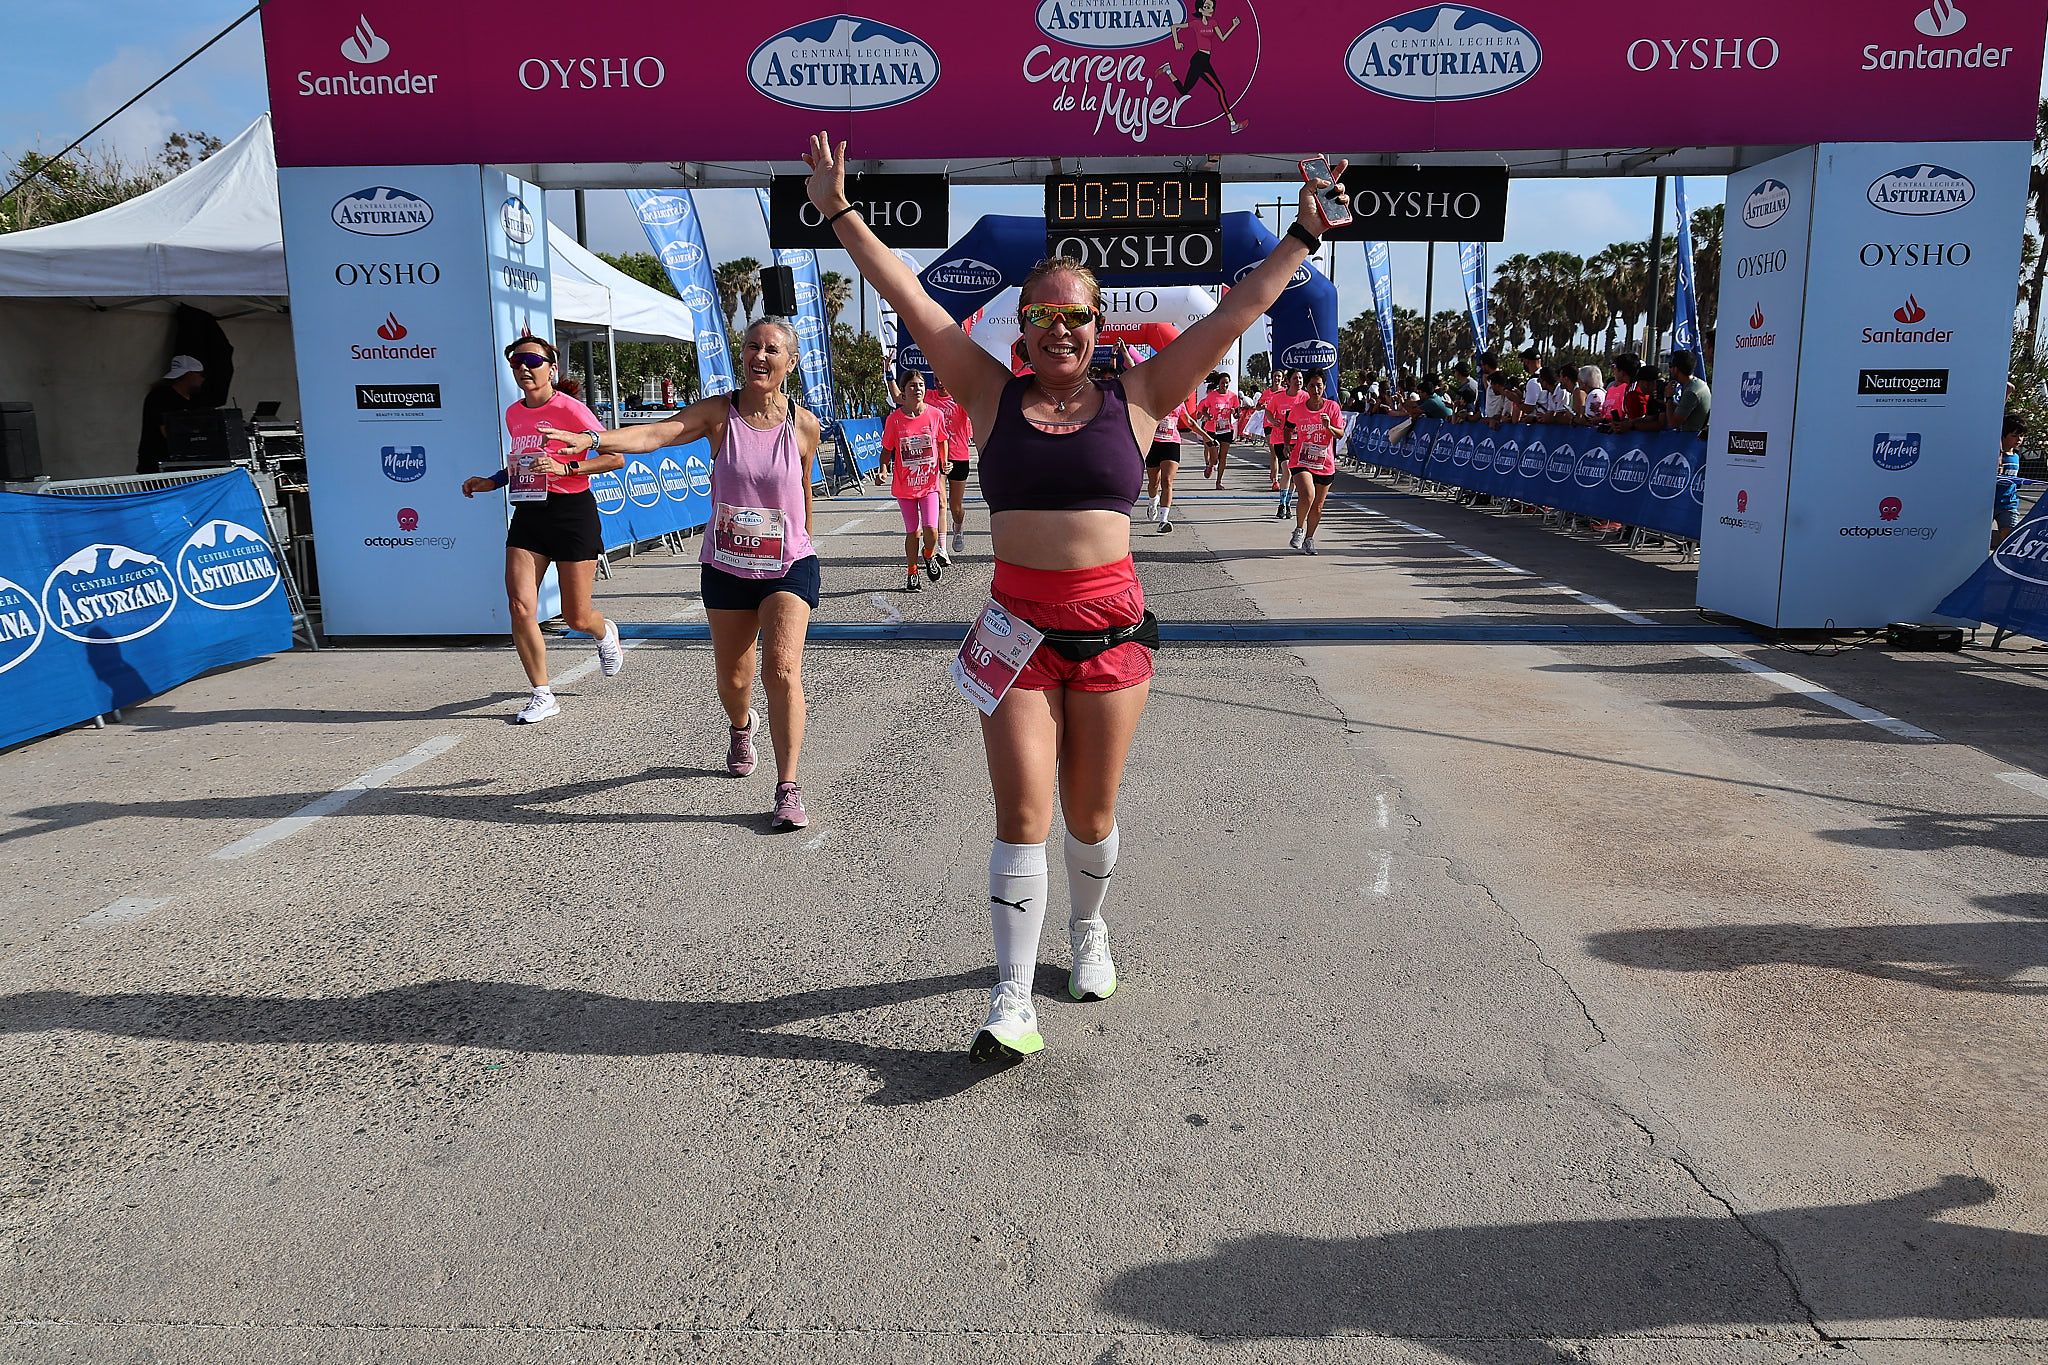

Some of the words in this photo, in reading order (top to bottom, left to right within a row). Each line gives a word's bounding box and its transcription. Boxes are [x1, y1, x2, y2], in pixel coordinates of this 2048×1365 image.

[1047, 2, 1174, 30] ASTURIANA
[791, 48, 850, 58] CENTRAL
[857, 48, 919, 57] LECHERA
[1391, 38, 1453, 48] CENTRAL
[1459, 37, 1521, 46] LECHERA
[1022, 44, 1146, 83] Carrera
[1359, 41, 1526, 77] ASTURIANA
[1627, 37, 1779, 71] OYSHO
[1862, 42, 2013, 70] Santander
[518, 56, 665, 90] OYSHO
[763, 52, 926, 86] ASTURIANA
[297, 69, 438, 96] Santander
[1052, 85, 1075, 112] de
[1080, 83, 1097, 112] la
[1093, 78, 1192, 143] Mujer
[1058, 181, 1208, 219] 00:36:04
[1874, 183, 1966, 203] ASTURIANA
[339, 205, 427, 224] ASTURIANA
[799, 200, 922, 227] OHO
[1353, 190, 1480, 219] OYSHO
[1745, 198, 1786, 220] ASTURIANA
[1055, 233, 1213, 268] OYSHO
[1859, 243, 1971, 266] OYSHO
[335, 262, 440, 286] OYSHO
[1737, 249, 1787, 279] OYSHO
[503, 265, 539, 292] OYSHO
[931, 270, 996, 286] ASTURIANA
[1735, 332, 1777, 349] Santander
[1862, 328, 1953, 343] Santander
[351, 344, 437, 360] Santander
[1865, 374, 1941, 391] Neutrogena
[361, 389, 435, 406] Neutrogena
[1730, 435, 1764, 452] Neutrogena
[1875, 441, 1918, 461] Marlene
[384, 453, 424, 473] Marlene
[519, 475, 535, 483] 016
[1650, 468, 1686, 489] ASTURIANA
[1720, 516, 1743, 528] octopus
[1839, 525, 1892, 539] octopus
[1893, 526, 1938, 540] energy
[364, 536, 414, 548] octopus
[414, 537, 456, 550] energy
[733, 535, 761, 547] 016
[197, 551, 231, 564] CENTRAL
[232, 544, 264, 559] LECHERA
[72, 577, 118, 593] CENTRAL
[187, 557, 276, 595] ASTURIANA
[57, 578, 172, 629] ASTURIANA
[970, 639, 993, 666] 016
